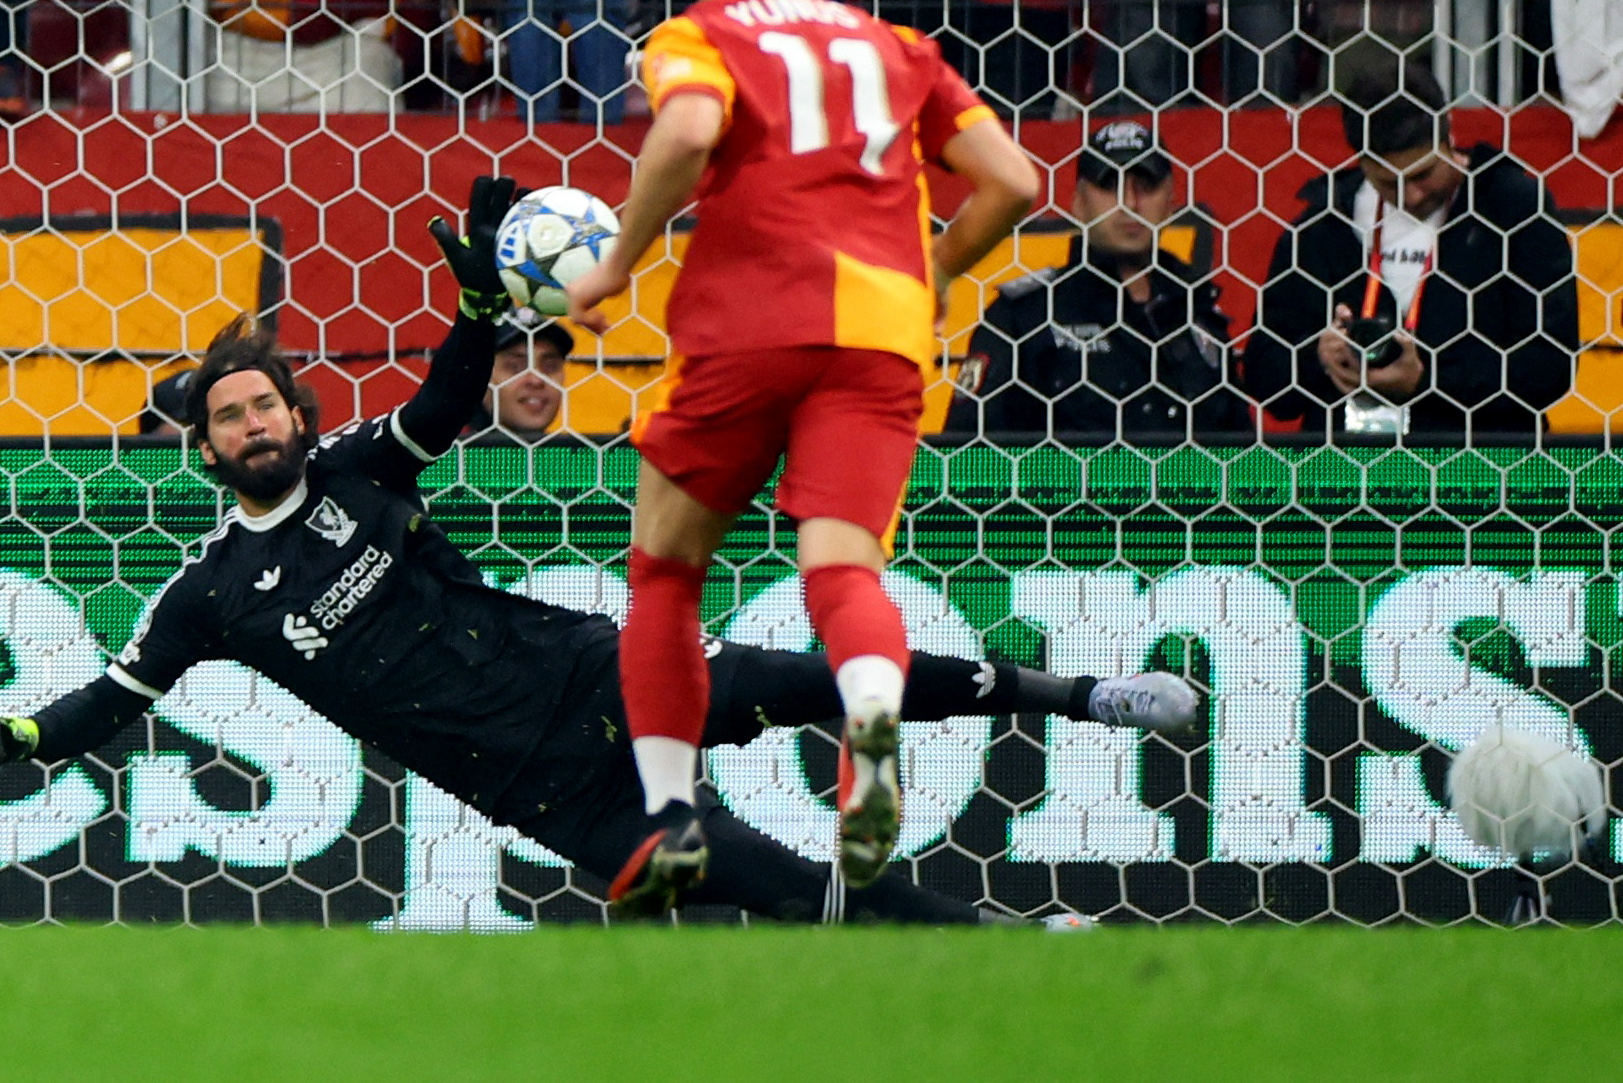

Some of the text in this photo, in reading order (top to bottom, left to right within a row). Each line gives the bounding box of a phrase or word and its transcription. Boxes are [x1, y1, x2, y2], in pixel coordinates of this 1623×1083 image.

[758, 31, 901, 177] 11
[309, 544, 380, 619] standard
[321, 550, 394, 631] chartered
